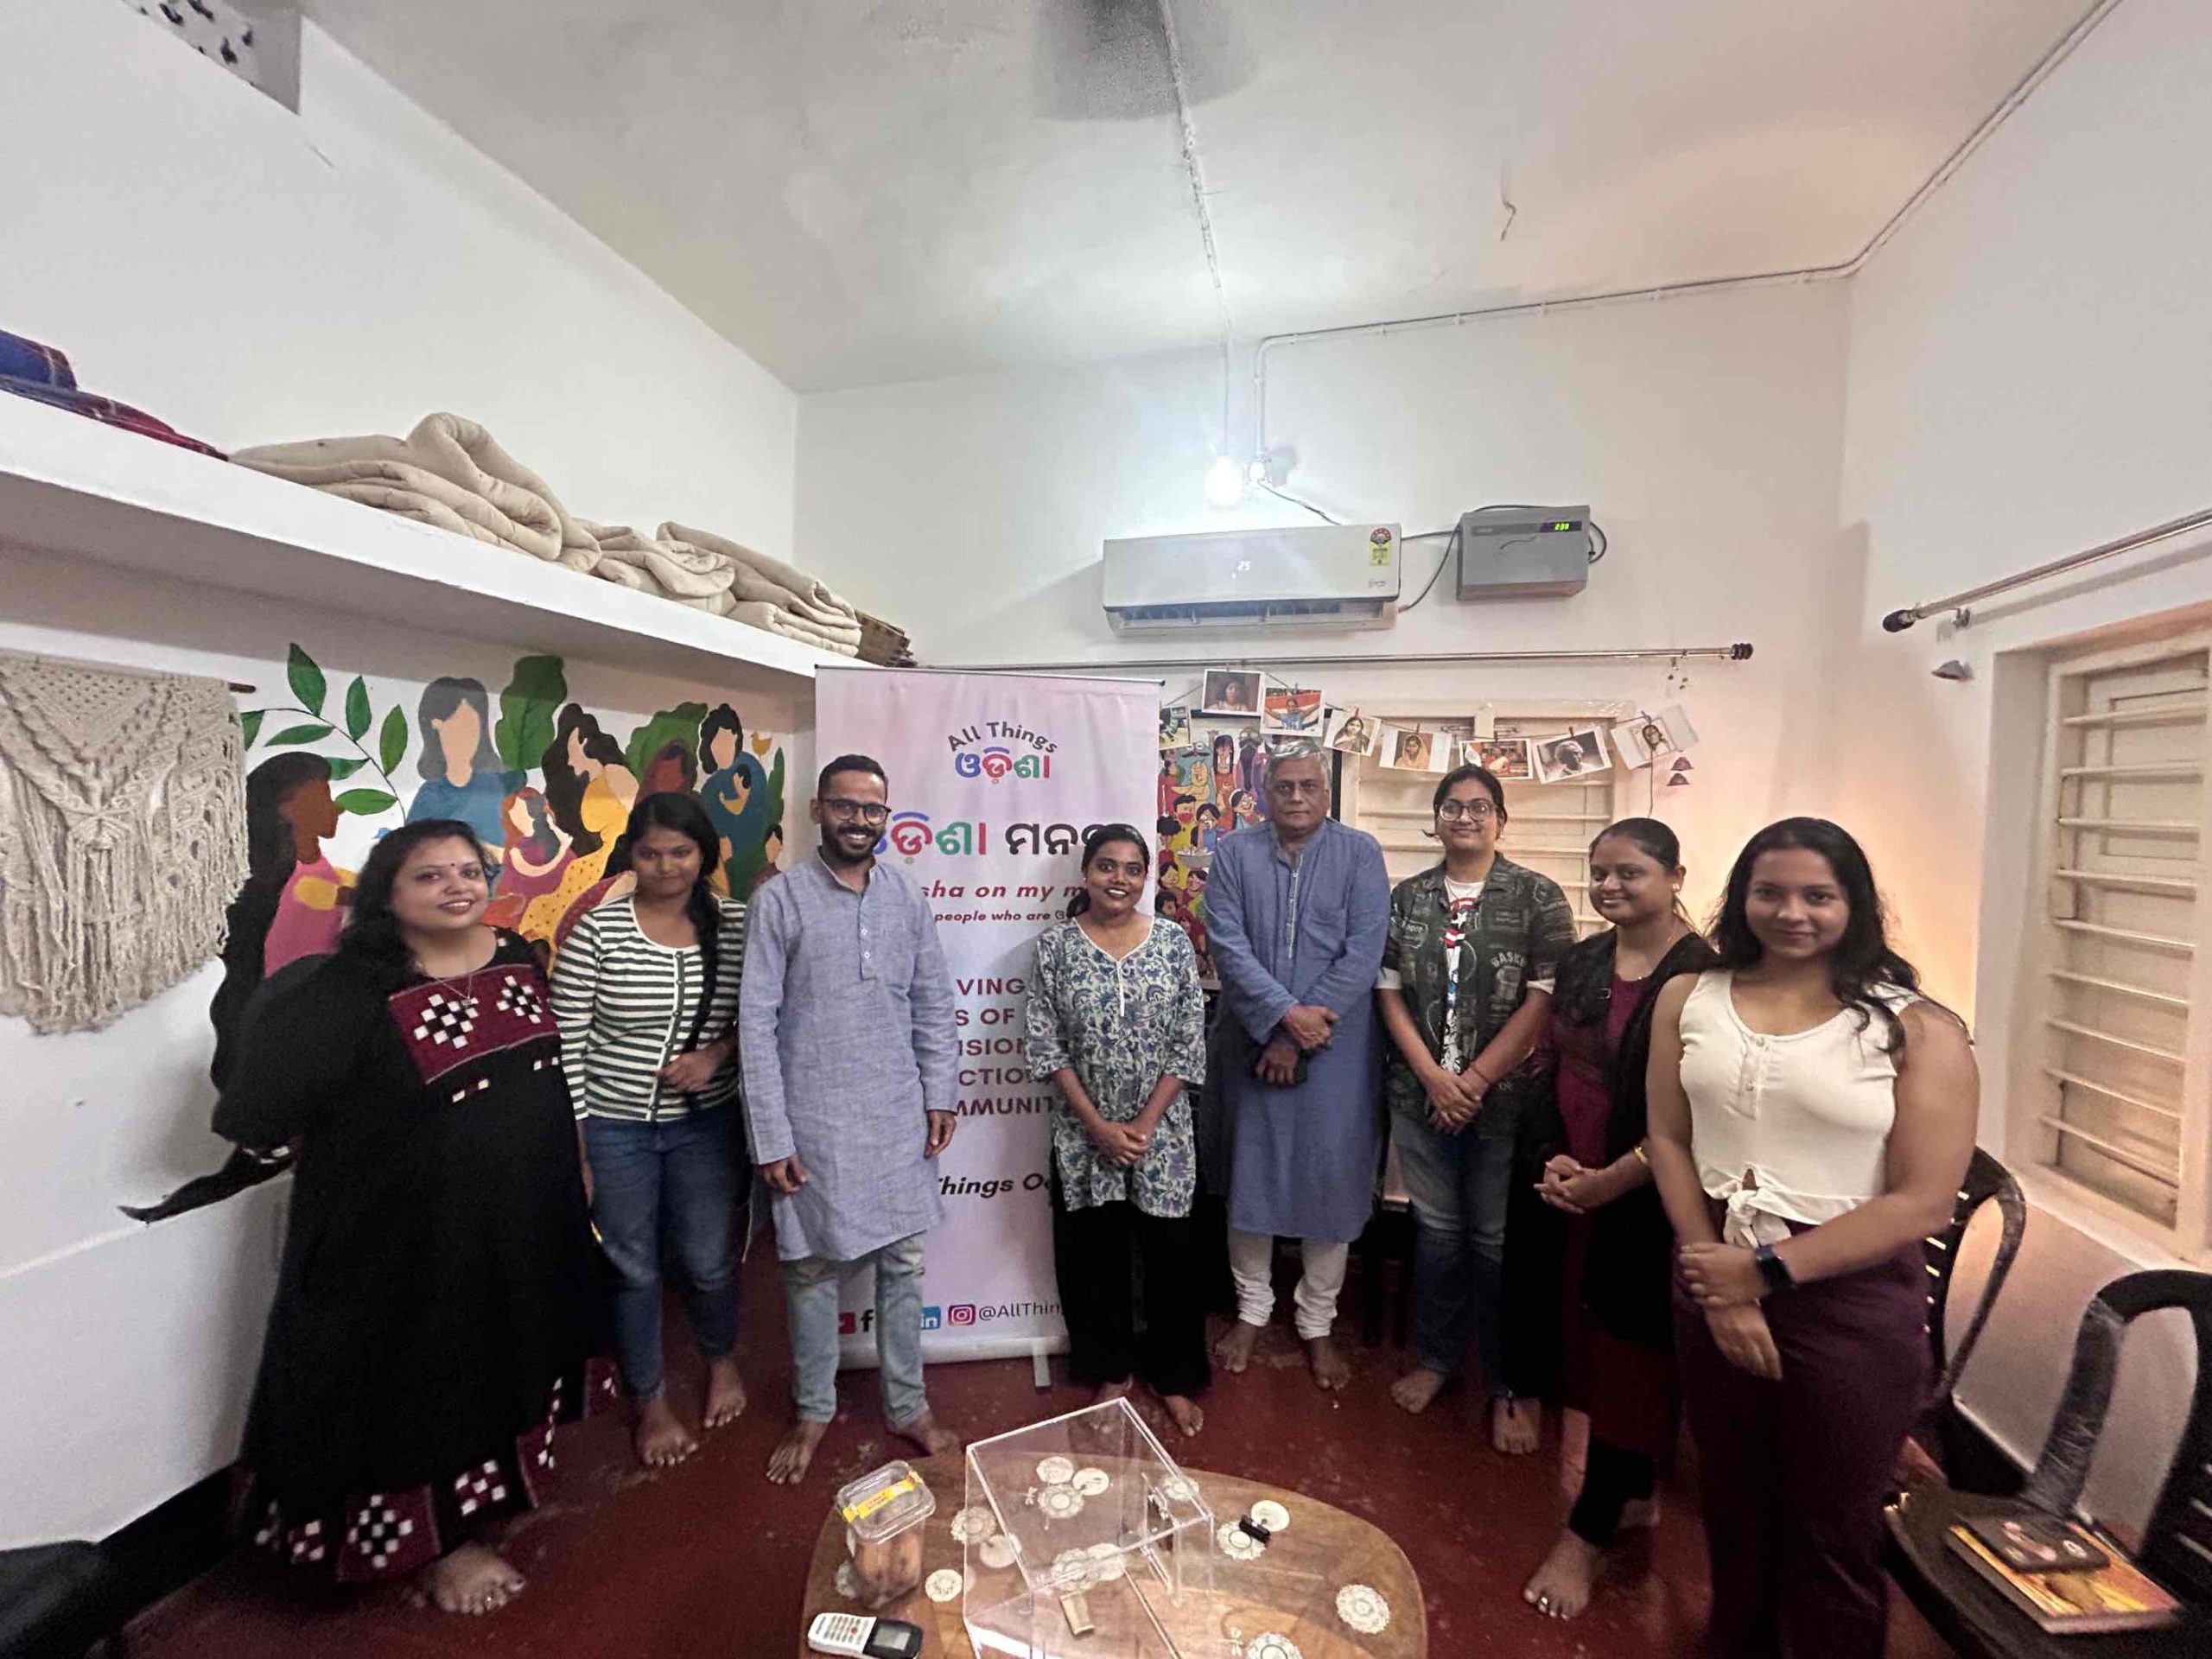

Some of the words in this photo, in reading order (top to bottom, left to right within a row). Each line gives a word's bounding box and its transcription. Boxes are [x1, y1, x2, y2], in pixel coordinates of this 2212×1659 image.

[948, 726, 981, 752] All
[986, 721, 1058, 753] Things
[921, 880, 964, 898] sha
[975, 887, 1006, 898] on
[1017, 886, 1054, 902] my
[935, 910, 986, 924] people
[991, 910, 1021, 921] who
[1027, 912, 1051, 920] are
[956, 978, 1026, 995] VING
[955, 1009, 969, 1026] S
[980, 1007, 1015, 1025] OF
[938, 1175, 1014, 1198] hings
[978, 1301, 1061, 1321] @AllThin
